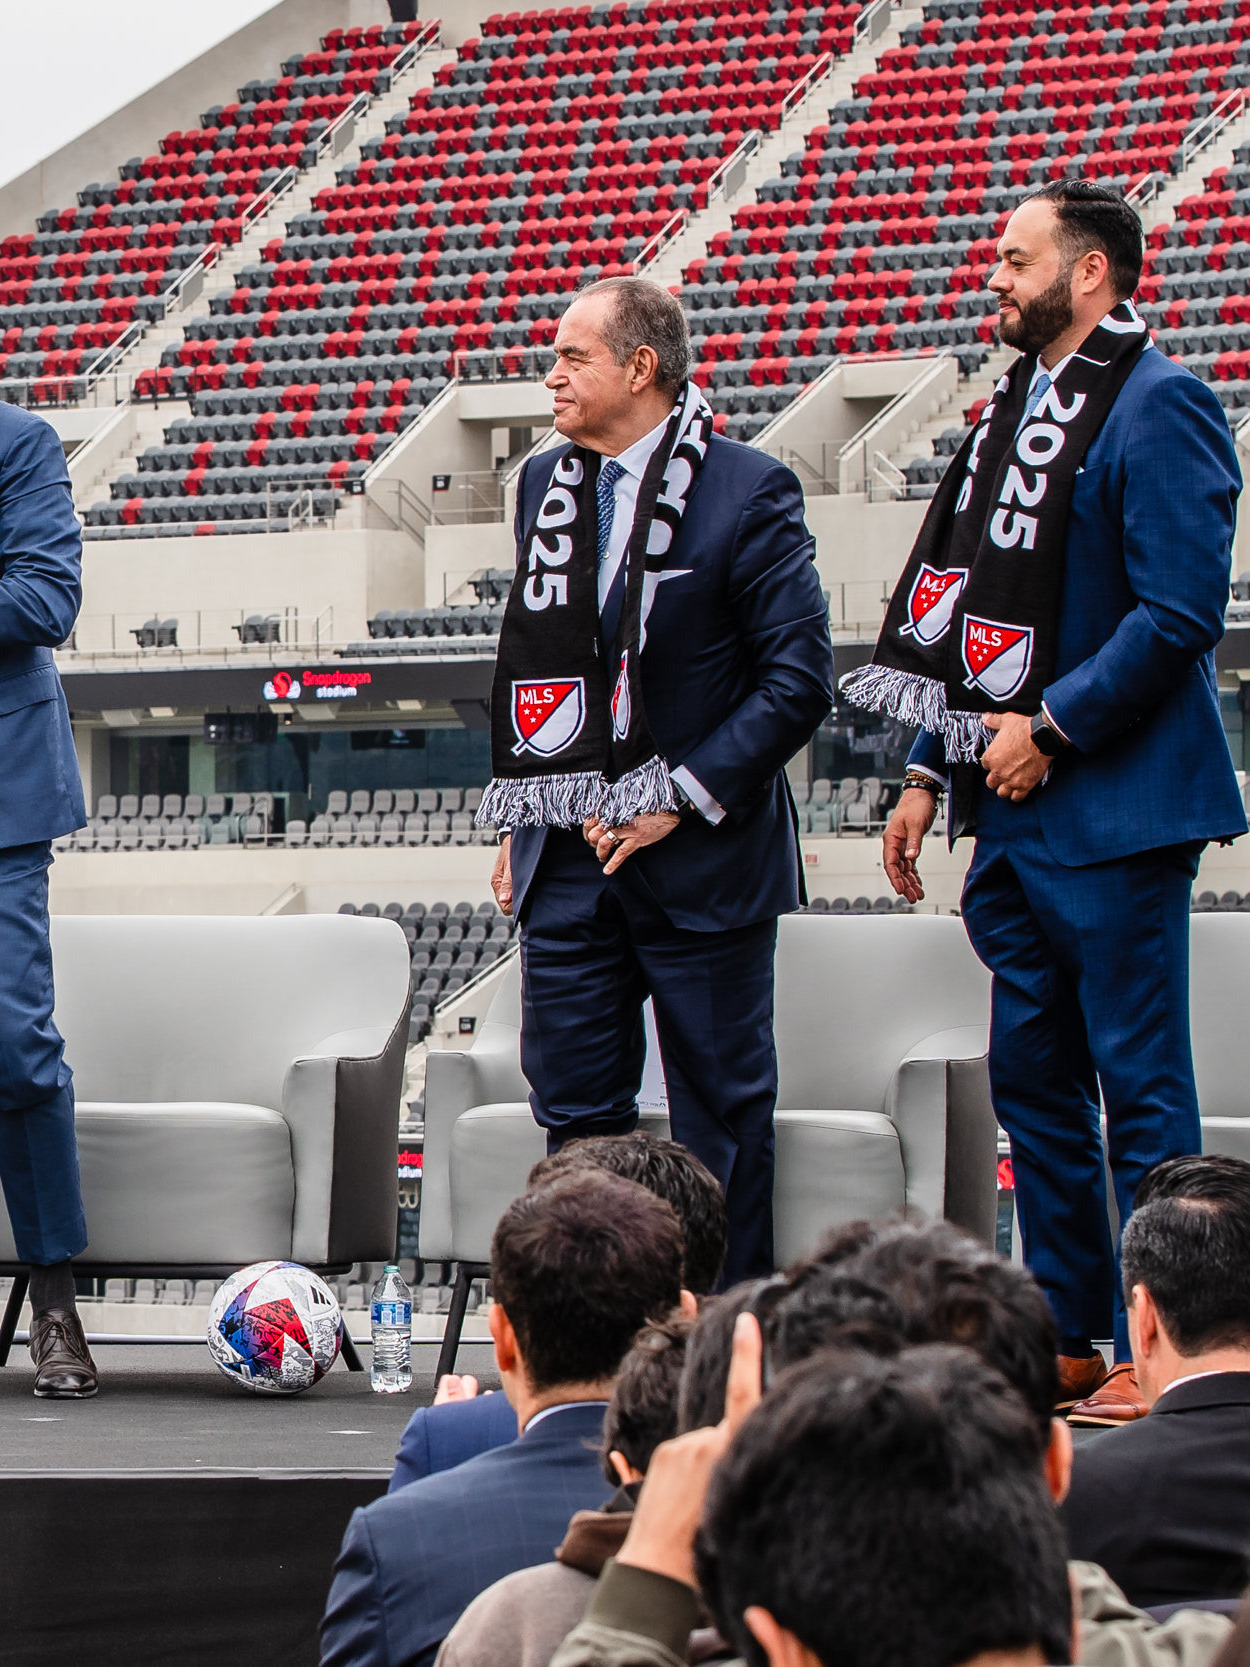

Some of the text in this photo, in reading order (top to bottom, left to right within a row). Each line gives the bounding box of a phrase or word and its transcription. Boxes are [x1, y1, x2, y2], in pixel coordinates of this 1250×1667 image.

[990, 384, 1087, 550] 2025
[523, 457, 584, 612] 2025
[920, 574, 947, 592] MLS
[969, 624, 1002, 647] MLS
[302, 670, 372, 687] Snapdragon
[316, 685, 357, 698] stadium
[520, 687, 555, 705] MLS
